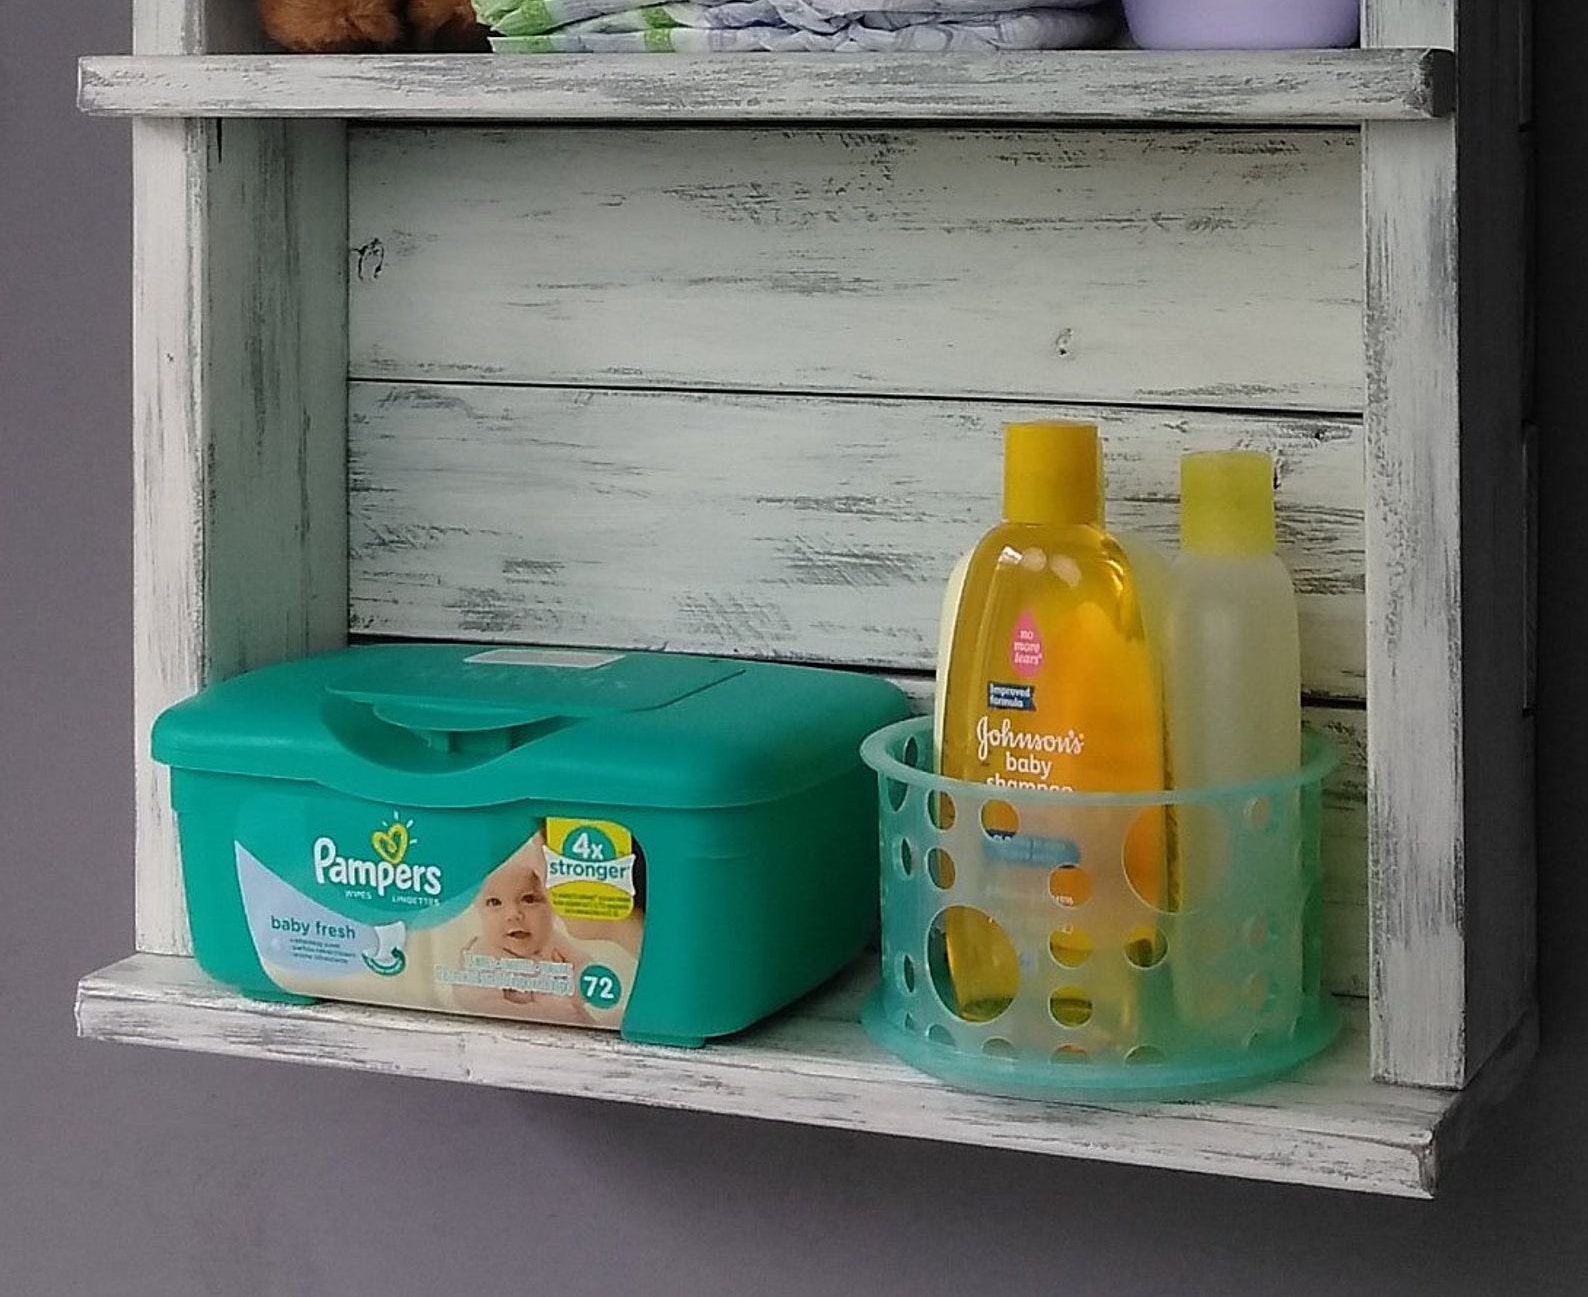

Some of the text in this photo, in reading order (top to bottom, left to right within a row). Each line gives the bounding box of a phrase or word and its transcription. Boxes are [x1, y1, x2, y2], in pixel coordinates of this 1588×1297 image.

[1014, 641, 1041, 653] more
[1020, 630, 1034, 640] no
[989, 695, 1024, 708] formula
[990, 683, 1031, 699] Improved
[976, 716, 1085, 761] Johnson's
[1006, 751, 1052, 780] baby
[572, 832, 604, 860] 4x
[313, 837, 442, 897] Pampers
[549, 859, 627, 881] stronger
[270, 915, 356, 939] baby fresh
[583, 975, 615, 1000] 72
